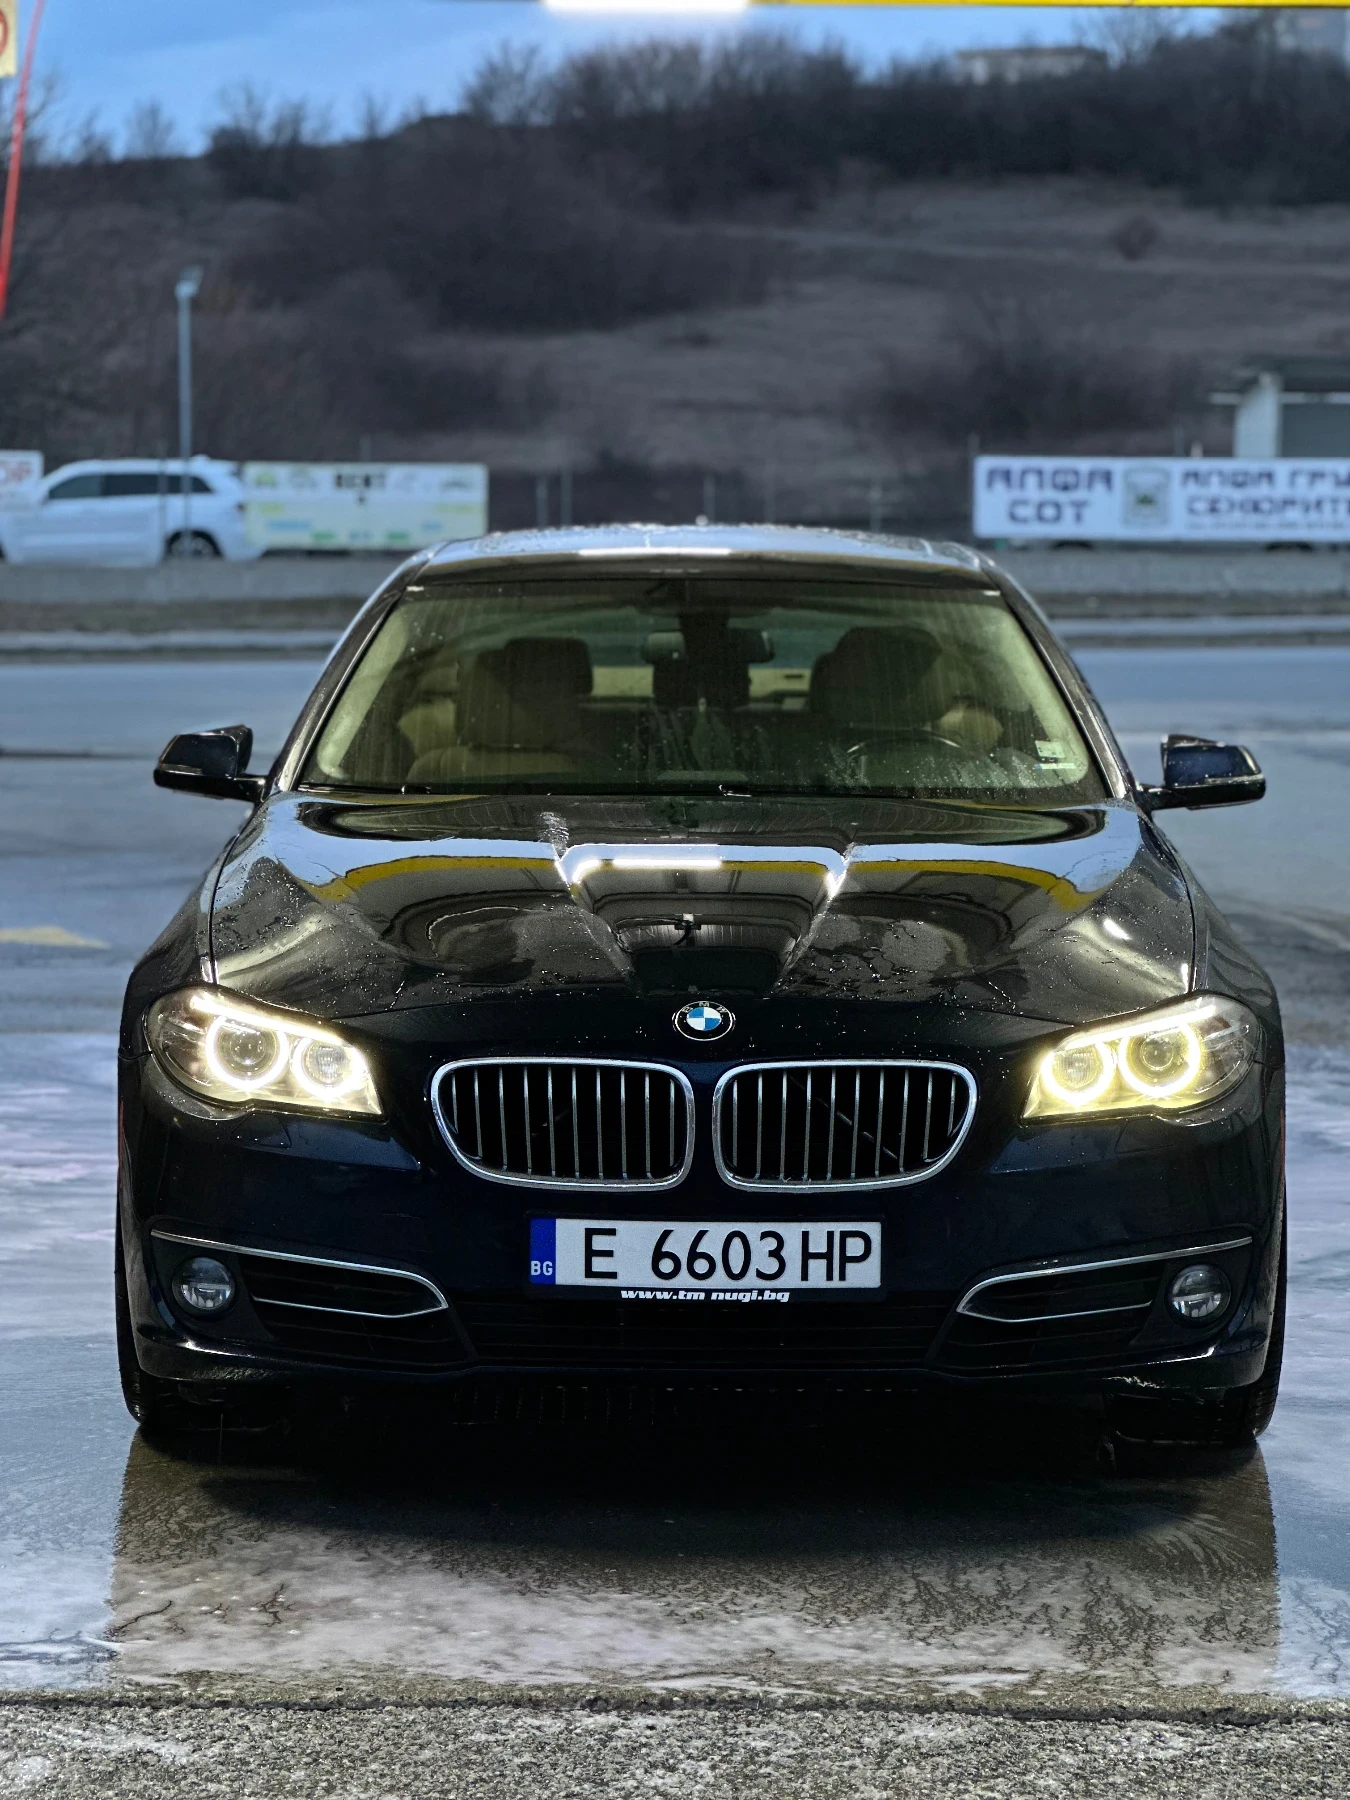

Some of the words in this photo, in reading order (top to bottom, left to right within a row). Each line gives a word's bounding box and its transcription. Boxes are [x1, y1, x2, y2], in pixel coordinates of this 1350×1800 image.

[682, 1000, 728, 1013] BMW
[584, 1227, 618, 1279] E
[651, 1229, 786, 1281] 6603
[800, 1230, 872, 1282] HP
[530, 1260, 553, 1276] BG
[621, 1290, 706, 1300] www.tm
[711, 1290, 790, 1303] nugi.bg
